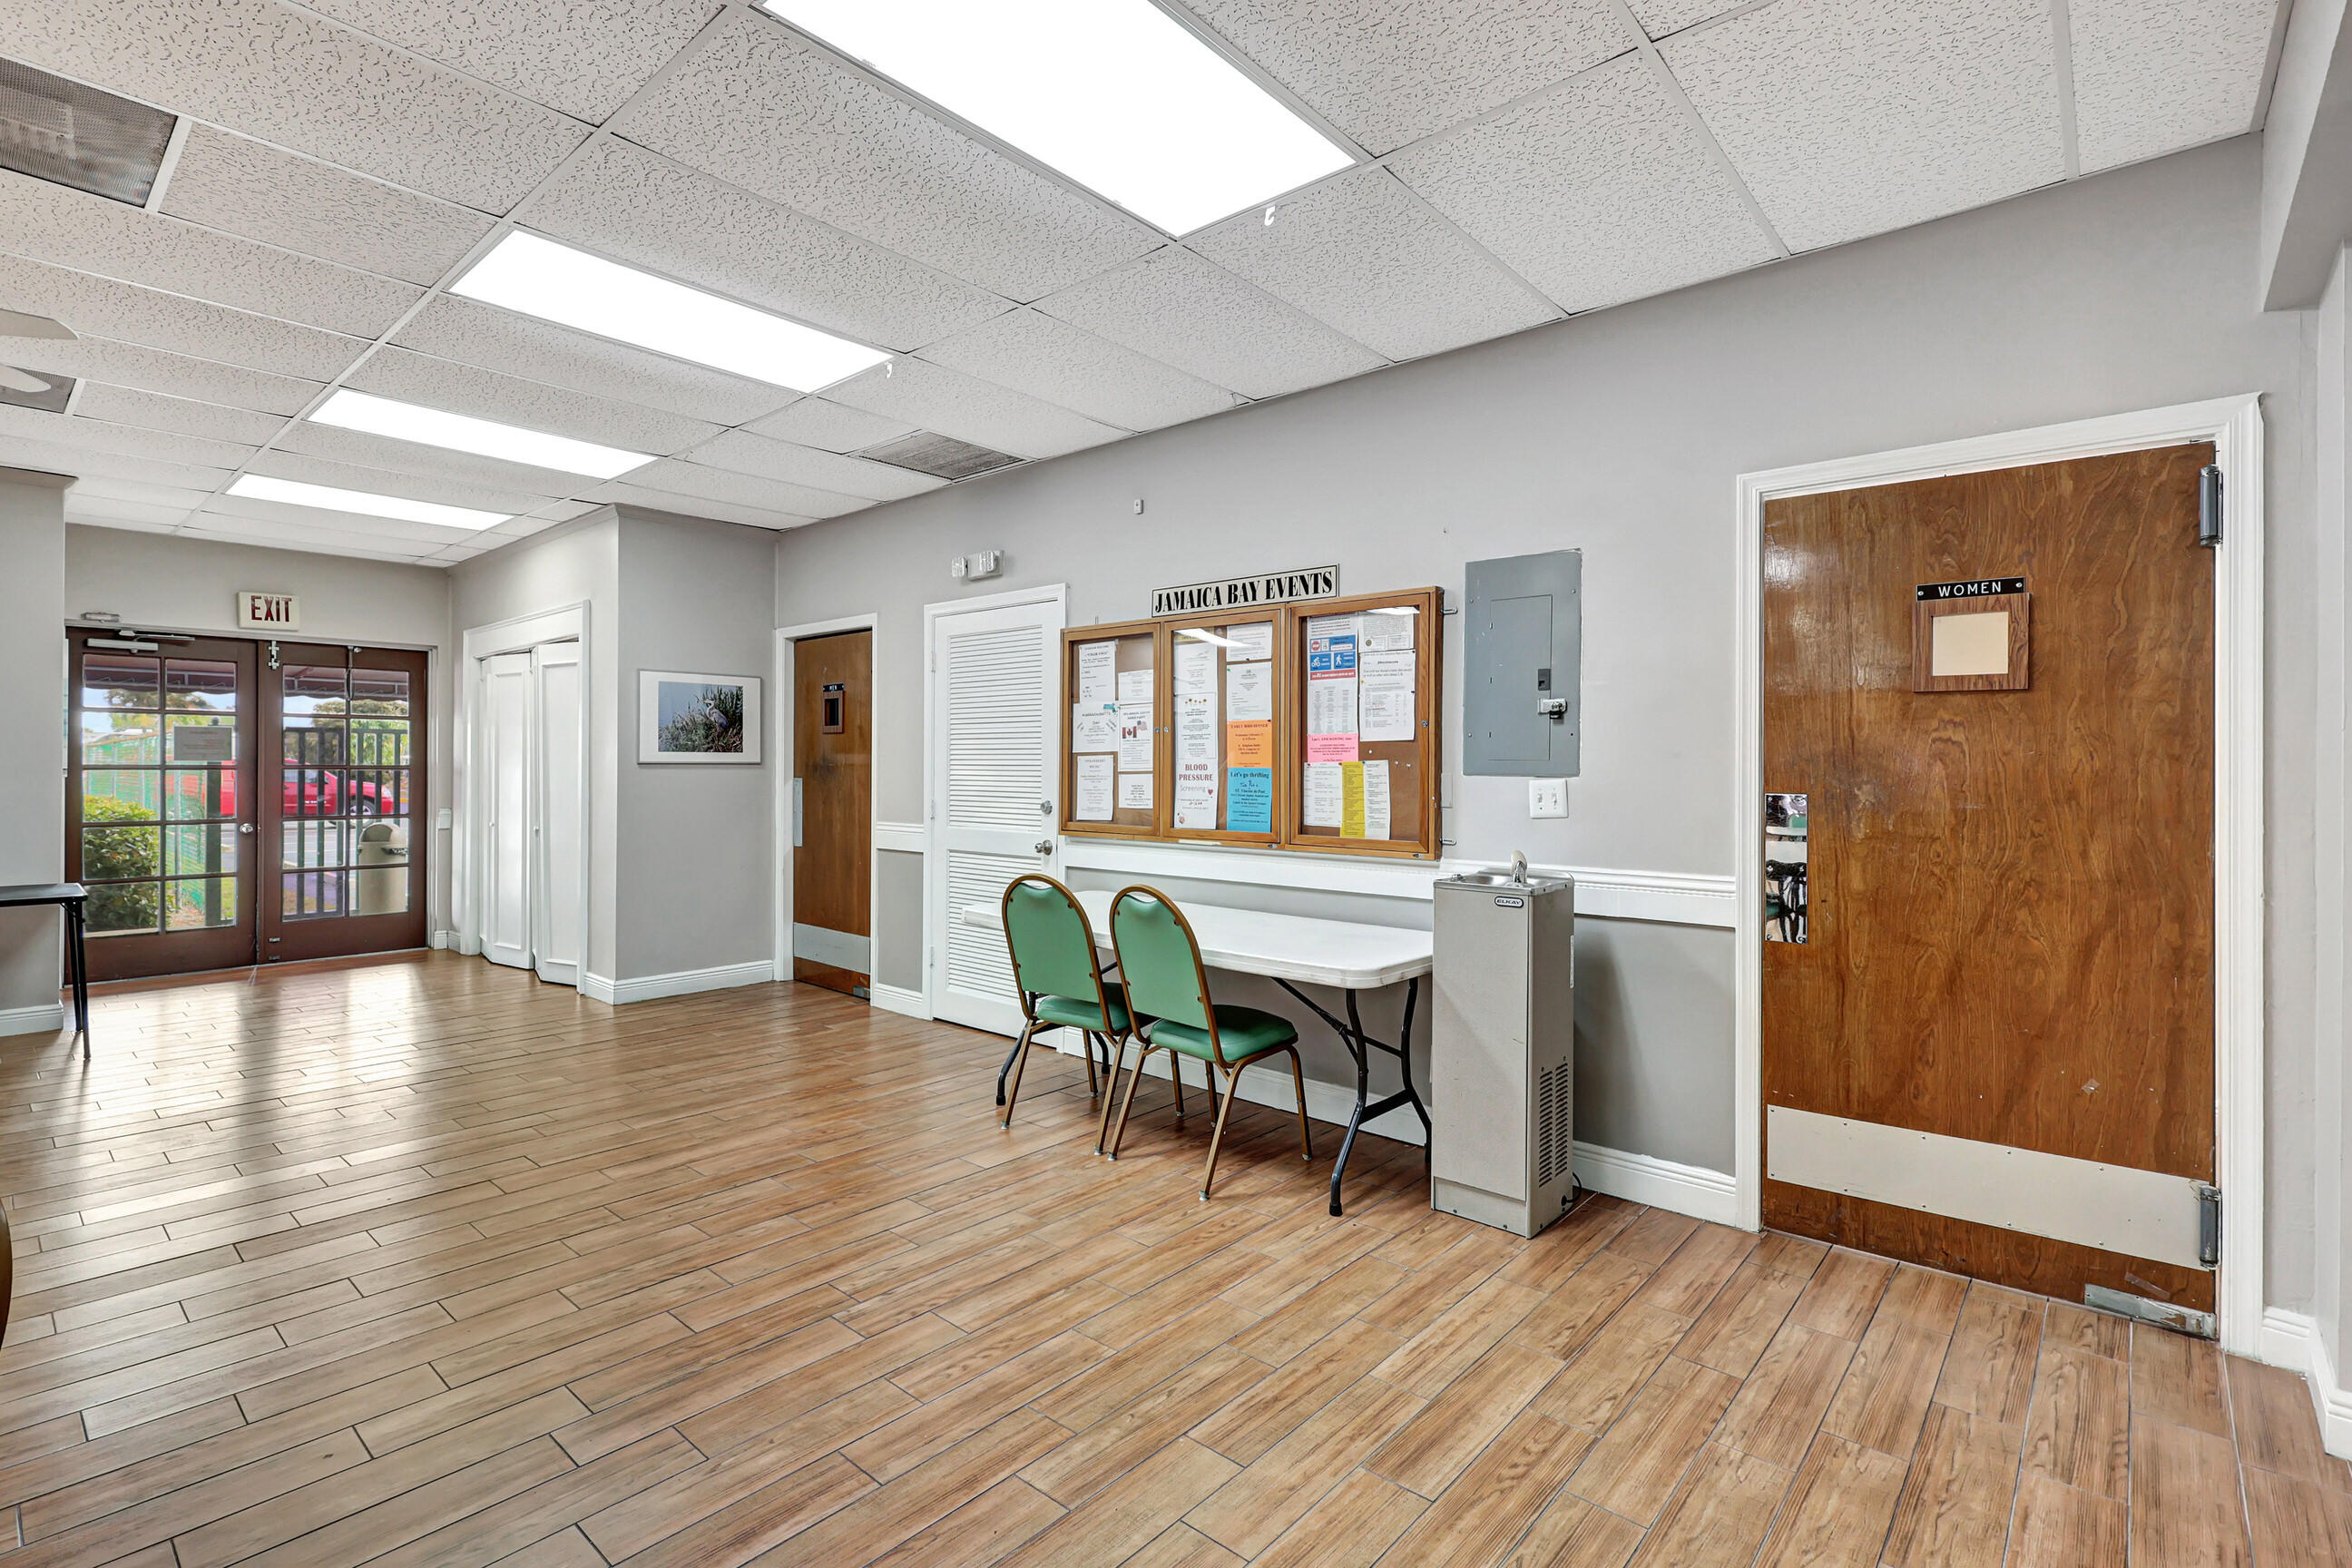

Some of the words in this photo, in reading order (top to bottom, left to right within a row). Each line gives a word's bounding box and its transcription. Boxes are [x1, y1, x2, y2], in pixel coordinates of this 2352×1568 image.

[1155, 585, 1222, 613] JAMAICA
[1227, 580, 1260, 604] BAY
[1265, 570, 1333, 600] EVENTS
[1937, 581, 2002, 597] WOMEN
[250, 594, 292, 622] EXIT
[1185, 763, 1209, 771] BLOOD
[1179, 773, 1213, 781] PRESSURE
[1180, 784, 1206, 793] Screening
